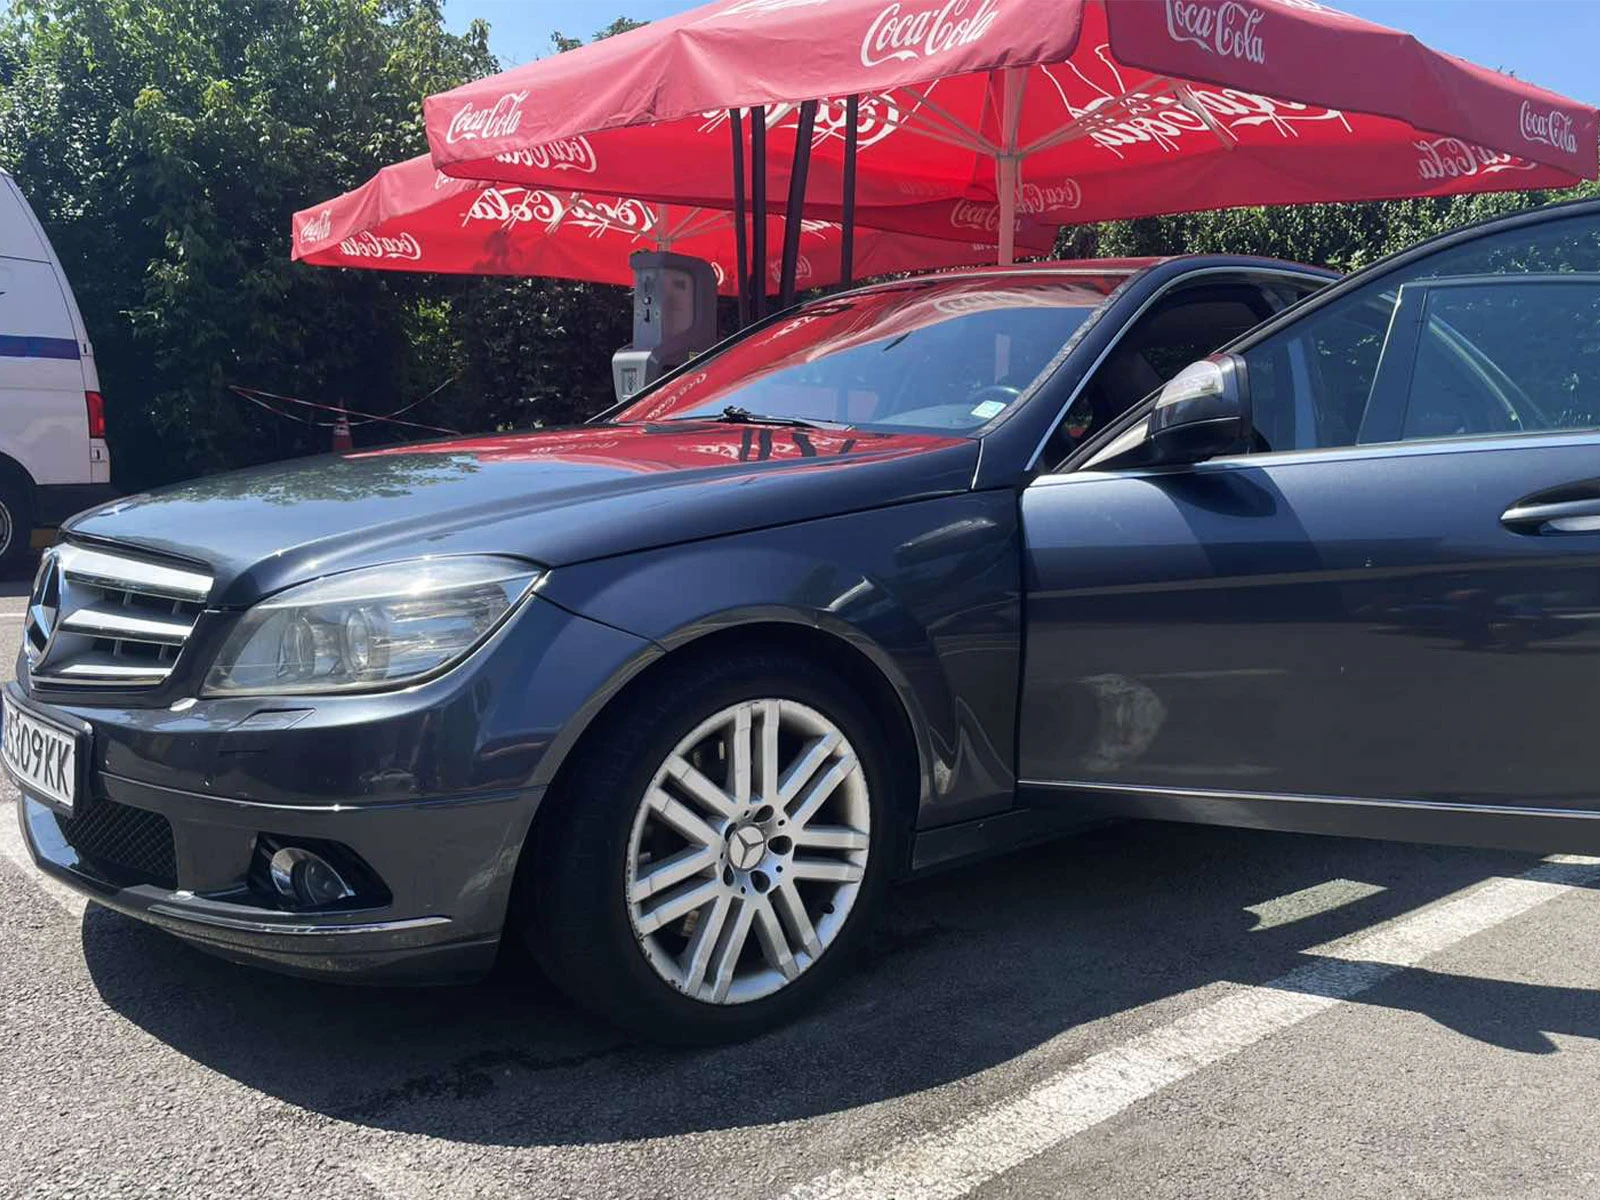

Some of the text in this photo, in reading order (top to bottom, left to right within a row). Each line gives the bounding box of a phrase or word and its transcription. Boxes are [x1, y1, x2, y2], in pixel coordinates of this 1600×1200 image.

[861, 0, 999, 67] Coca-Cola
[1165, 0, 1266, 65] Coca-Cola
[446, 89, 530, 144] Coca-Cola
[1519, 100, 1578, 153] Coca-Cola
